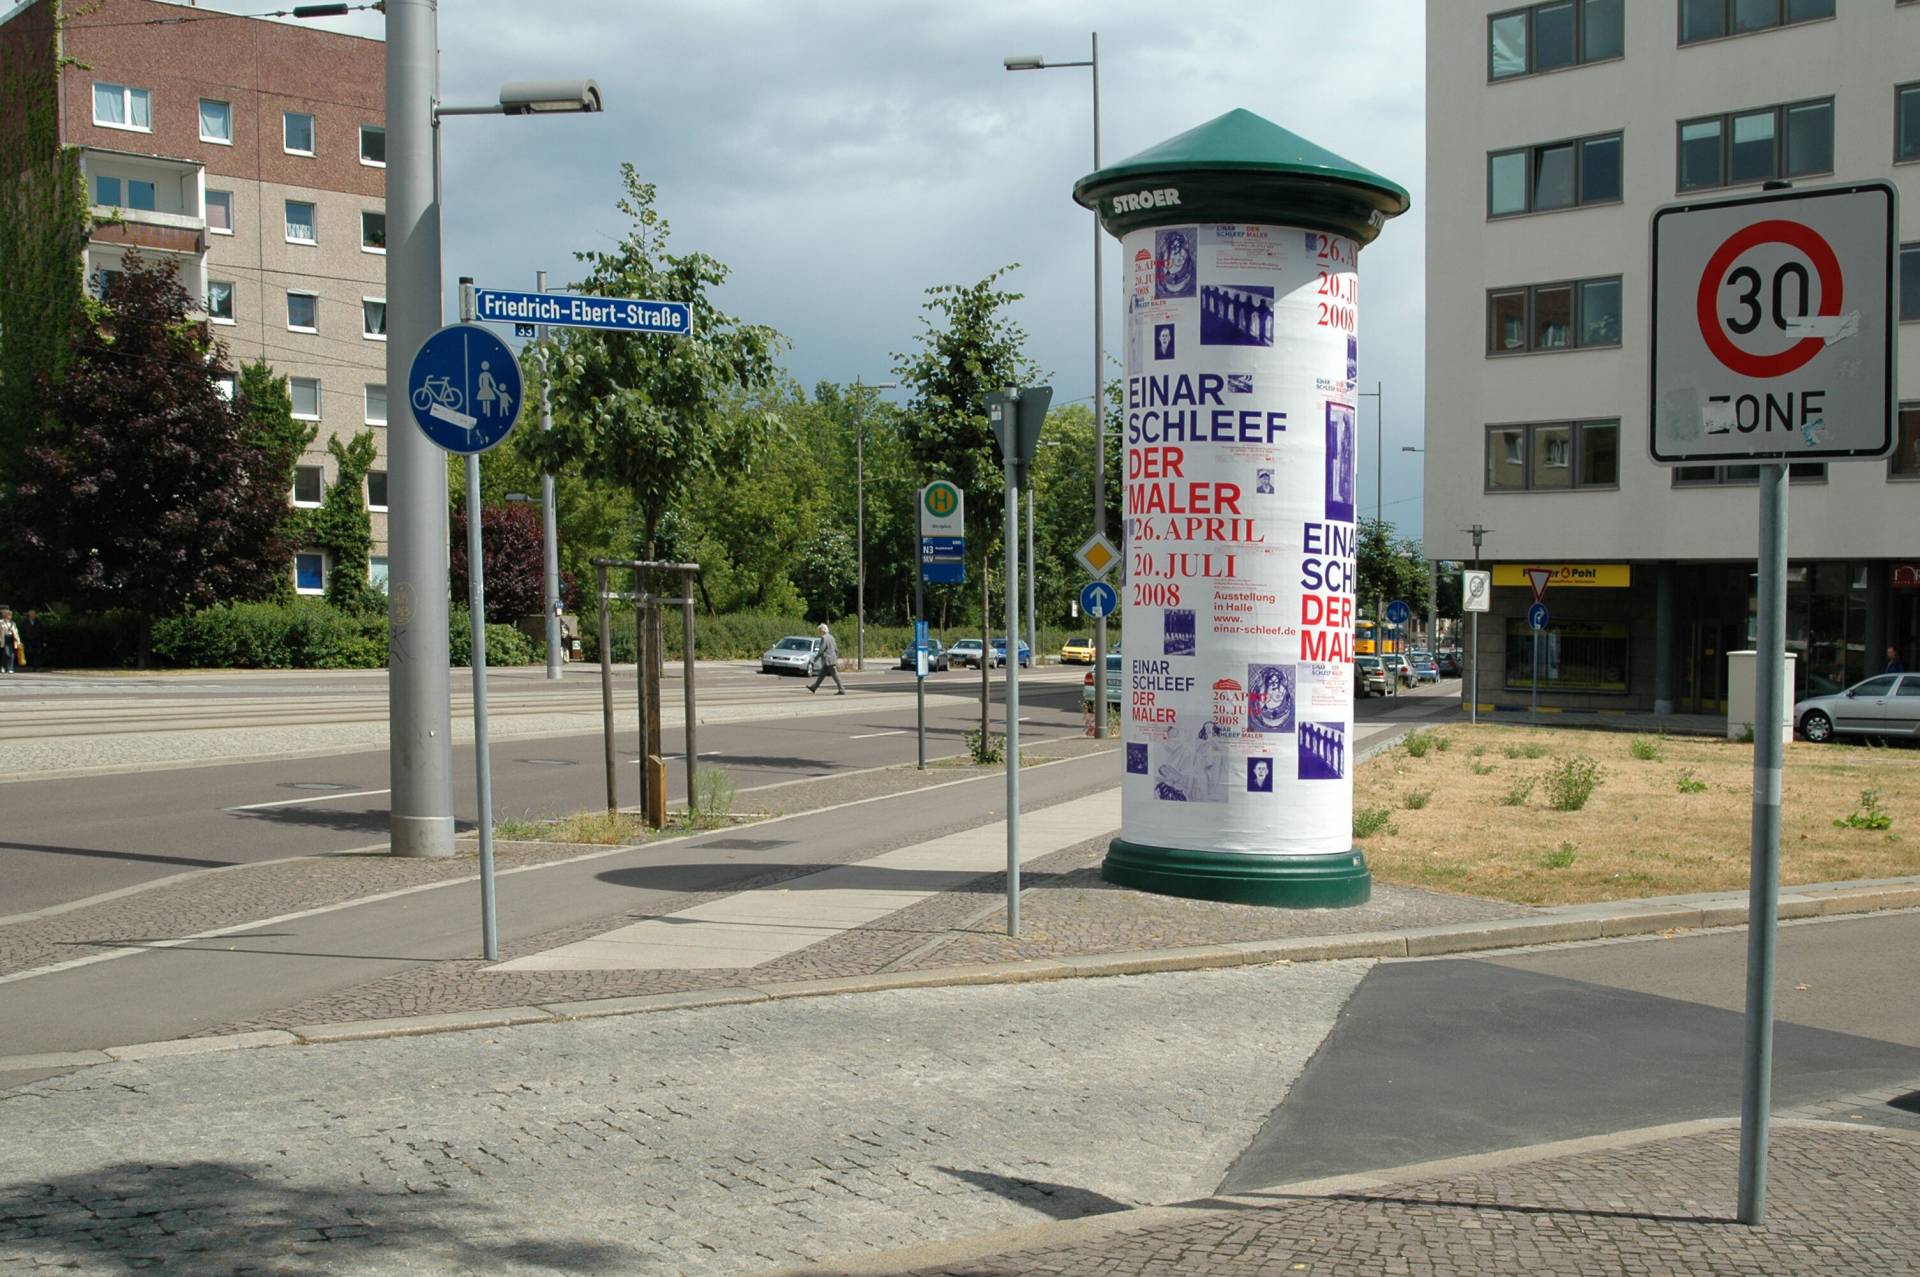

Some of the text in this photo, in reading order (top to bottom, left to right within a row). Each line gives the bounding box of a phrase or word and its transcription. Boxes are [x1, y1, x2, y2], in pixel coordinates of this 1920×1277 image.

[1726, 261, 1809, 335] 30
[484, 294, 681, 327] Friedrich-Ebert-Straße
[1317, 302, 1354, 333] 2008
[1129, 374, 1225, 409] EINAR
[1129, 410, 1288, 445] SCHLEEF
[1129, 446, 1184, 480] DER
[1129, 482, 1241, 515] MALER
[923, 545, 934, 554] N3
[1572, 568, 1596, 578] Pohl
[1133, 583, 1181, 608] 2008
[1214, 591, 1276, 604] Ausstellung
[1214, 602, 1253, 612] in Halle
[1302, 594, 1351, 628] DER
[1214, 615, 1243, 623] www.
[1214, 624, 1296, 636] einar-schleef.de
[1132, 659, 1170, 675] EINAR
[1132, 675, 1195, 691] SCHLEEF
[1132, 691, 1156, 706] DER
[1132, 707, 1176, 723] MALER
[1213, 716, 1239, 726] 2008
